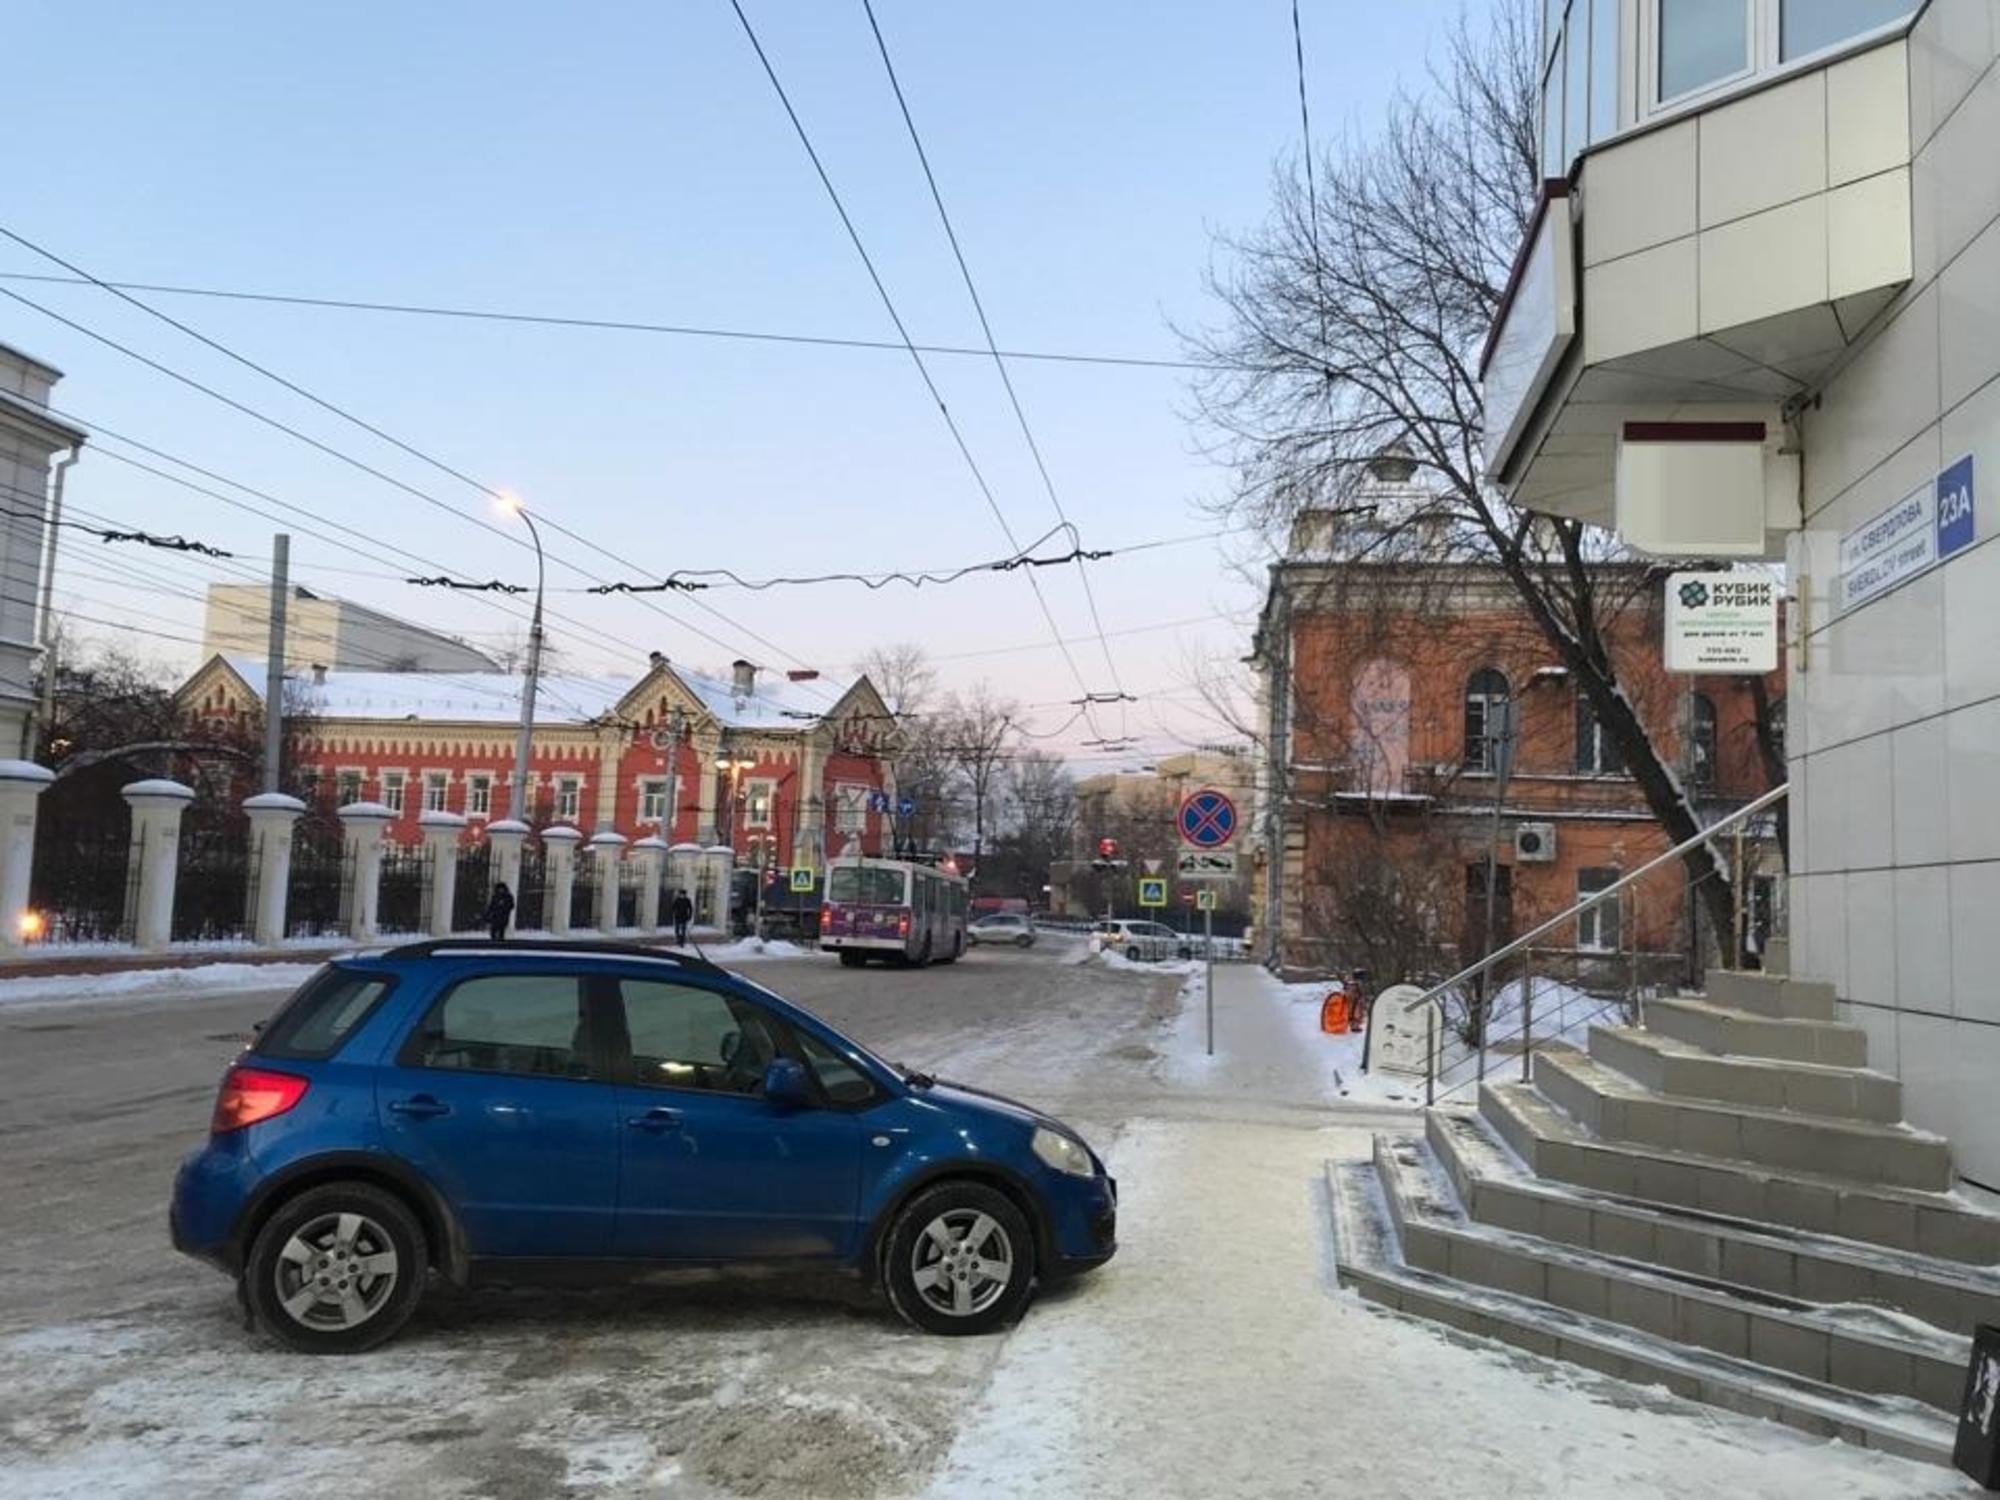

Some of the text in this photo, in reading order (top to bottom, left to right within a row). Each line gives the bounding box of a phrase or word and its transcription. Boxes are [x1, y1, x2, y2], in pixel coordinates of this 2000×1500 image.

[1861, 500, 1922, 551] СВЕРДЛОВА
[1713, 583, 1771, 594] КУБИК
[1713, 595, 1771, 606] РУБИК
